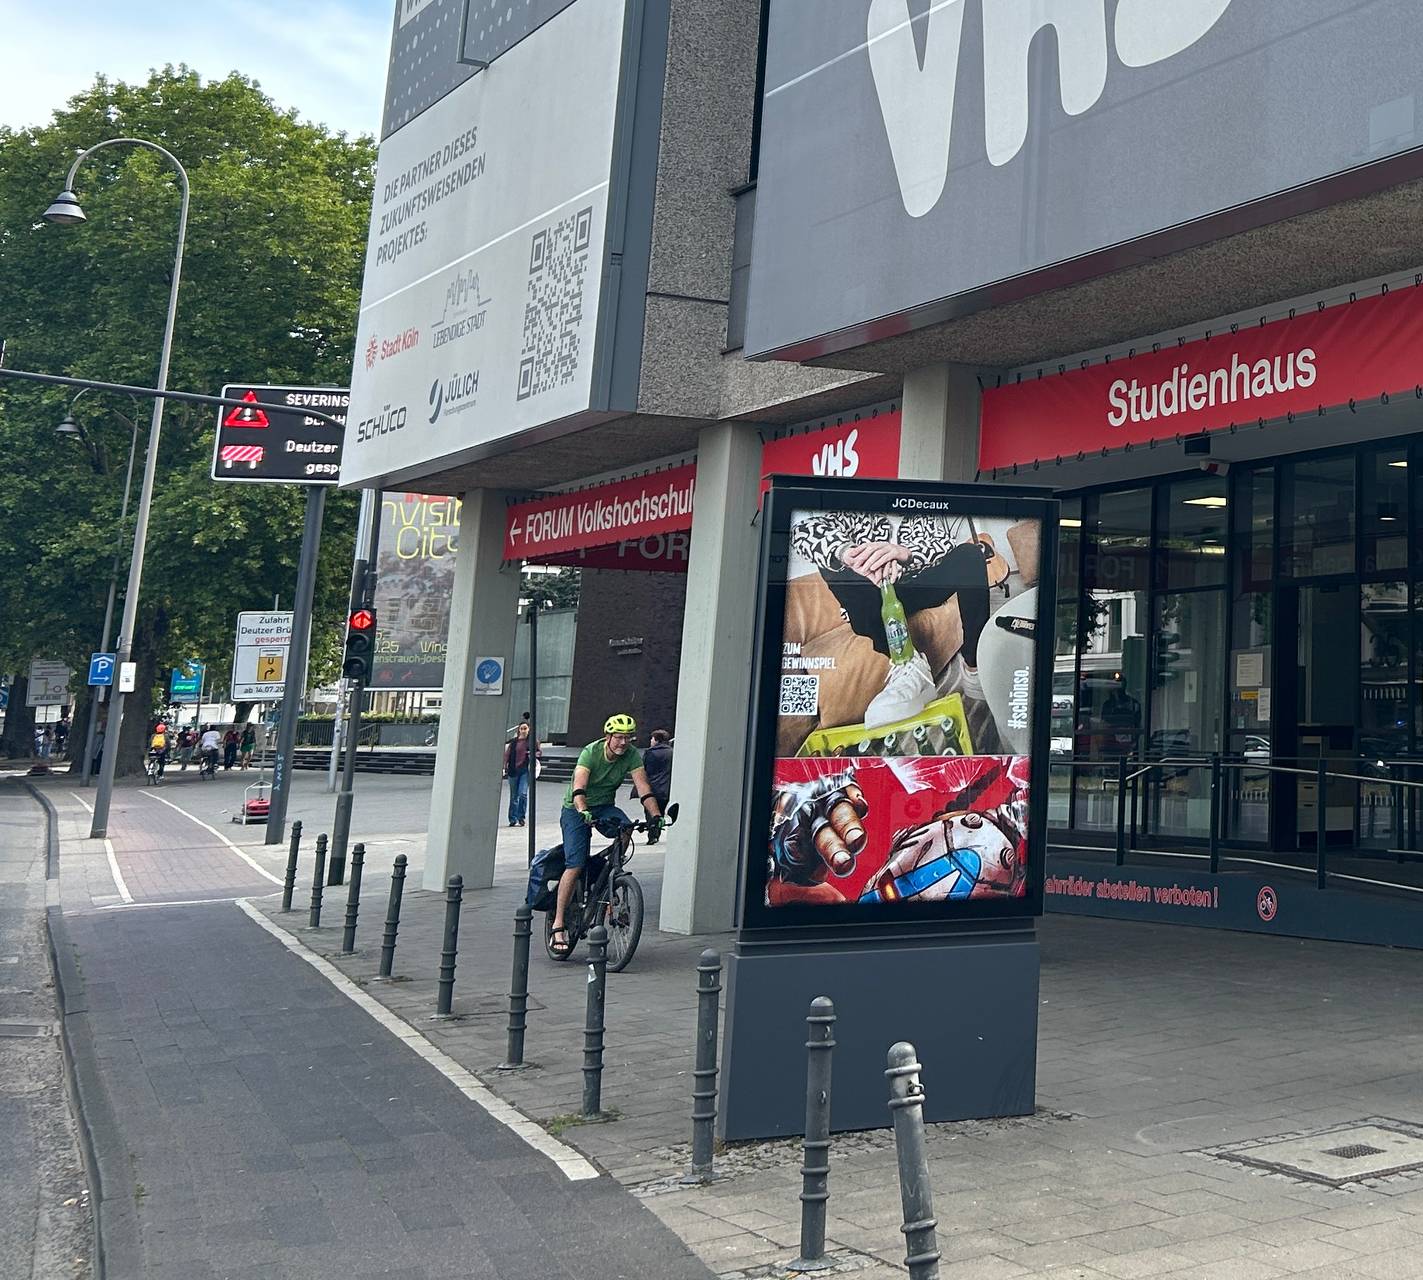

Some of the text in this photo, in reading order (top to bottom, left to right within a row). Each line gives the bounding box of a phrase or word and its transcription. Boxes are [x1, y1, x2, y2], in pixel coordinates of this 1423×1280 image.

[383, 126, 478, 204] DIE PARTNER DIESES
[379, 152, 487, 236] ZUKUNFTSWEISENDEN
[376, 220, 429, 268] PROJEKTES:
[380, 326, 420, 361] Stadt Köln
[286, 393, 350, 408] SEVERINS
[444, 369, 480, 404] JÜLICH
[1106, 346, 1318, 428] Studienhaus
[356, 403, 408, 443] SCHÜCO
[286, 440, 339, 454] Deutzer
[812, 428, 860, 477] VHS
[525, 478, 697, 545] FORUM Volkshochschul
[892, 497, 949, 511] JCDecaux
[241, 626, 275, 635] Deutzer
[258, 616, 290, 625] Zufahrt
[267, 657, 275, 665] U
[781, 656, 837, 670] GEWINNSPIEL
[782, 642, 802, 655] ZUM
[97, 660, 109, 673] P
[1007, 665, 1030, 729] #schönso.
[1044, 874, 1095, 897] ahrräder
[1096, 877, 1151, 902] abstellen
[1153, 883, 1212, 908] verboten
